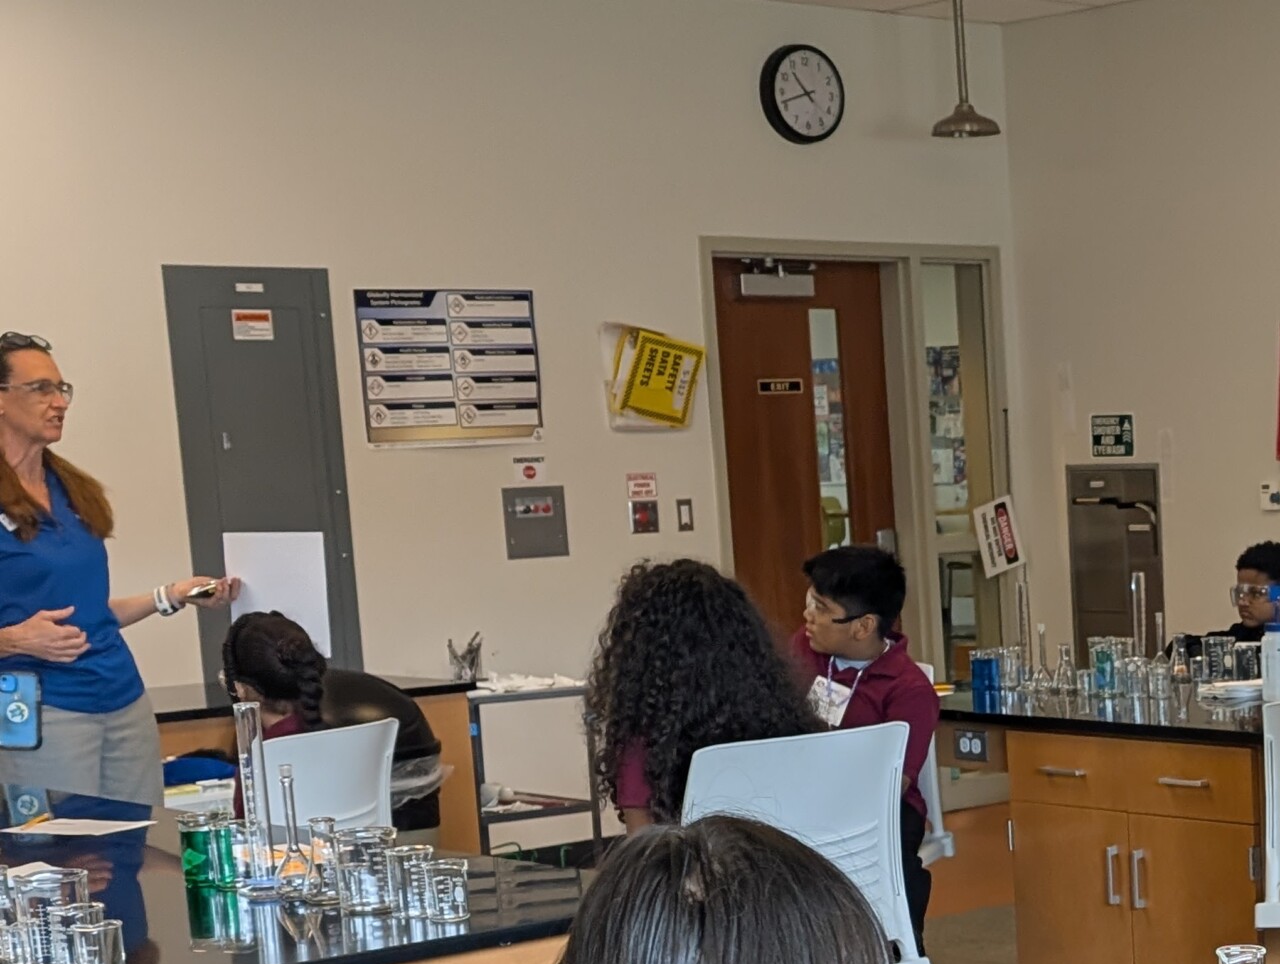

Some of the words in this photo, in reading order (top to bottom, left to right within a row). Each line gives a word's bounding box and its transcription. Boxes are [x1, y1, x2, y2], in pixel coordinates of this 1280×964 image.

[789, 60, 796, 70] 11
[800, 57, 808, 66] 12
[780, 72, 788, 82] 10
[826, 76, 831, 86] 2
[779, 88, 784, 96] 9
[828, 92, 834, 102] 3
[826, 106, 832, 116] 4
[794, 115, 799, 124] 7
[818, 117, 824, 127] 5
[806, 120, 812, 130] 6
[640, 346, 658, 387] SHEETS
[656, 350, 670, 376] DATA
[665, 353, 682, 392] SAFETY
[770, 382, 790, 390] EXIT
[1093, 426, 1121, 435] SHOWER
[1101, 436, 1116, 444] AND
[1094, 445, 1126, 454] EYEWASH
[513, 456, 544, 464] EMERGENCY
[998, 514, 1014, 550] DANGER
